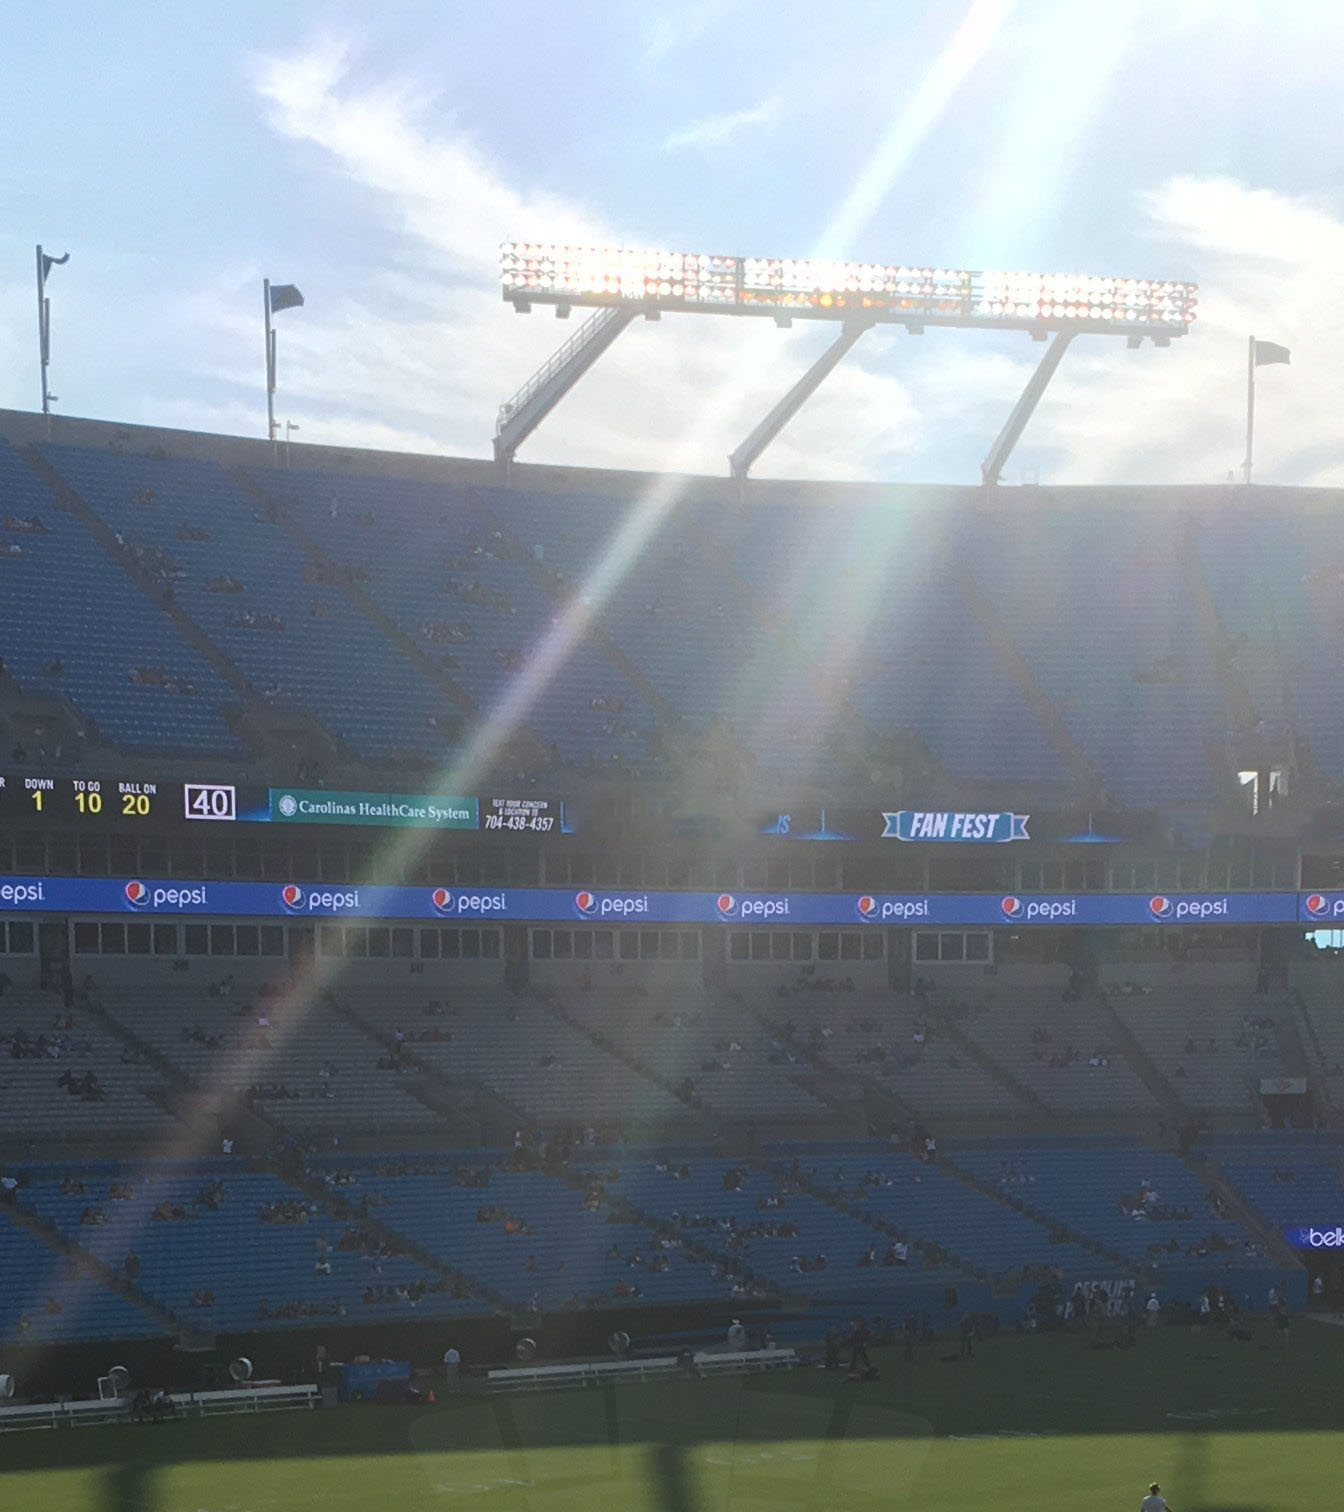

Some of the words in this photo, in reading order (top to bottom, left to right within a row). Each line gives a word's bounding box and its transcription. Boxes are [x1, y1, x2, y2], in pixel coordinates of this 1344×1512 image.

[25, 778, 54, 790] DOWN
[72, 779, 84, 791] TO
[86, 780, 101, 791] GO
[118, 783, 140, 794] BALL
[142, 783, 157, 794] ON
[32, 790, 43, 811] 1
[75, 792, 102, 813] 10
[121, 794, 150, 816] 20
[192, 789, 228, 816] 40
[299, 801, 355, 815] Carolinas
[360, 803, 426, 819] HealthCare
[429, 806, 469, 822] System
[485, 815, 554, 831] 704-438-4357
[909, 812, 946, 838] FAN
[951, 812, 1000, 839] FEST
[154, 886, 207, 907] pepsi
[308, 890, 359, 910] pepsi
[458, 893, 506, 912] pepsi
[601, 895, 648, 914] pepsi
[741, 898, 789, 916] pepsi
[882, 899, 929, 917] pepsi
[1027, 900, 1076, 918] pepsi
[1177, 898, 1228, 918] pepsi
